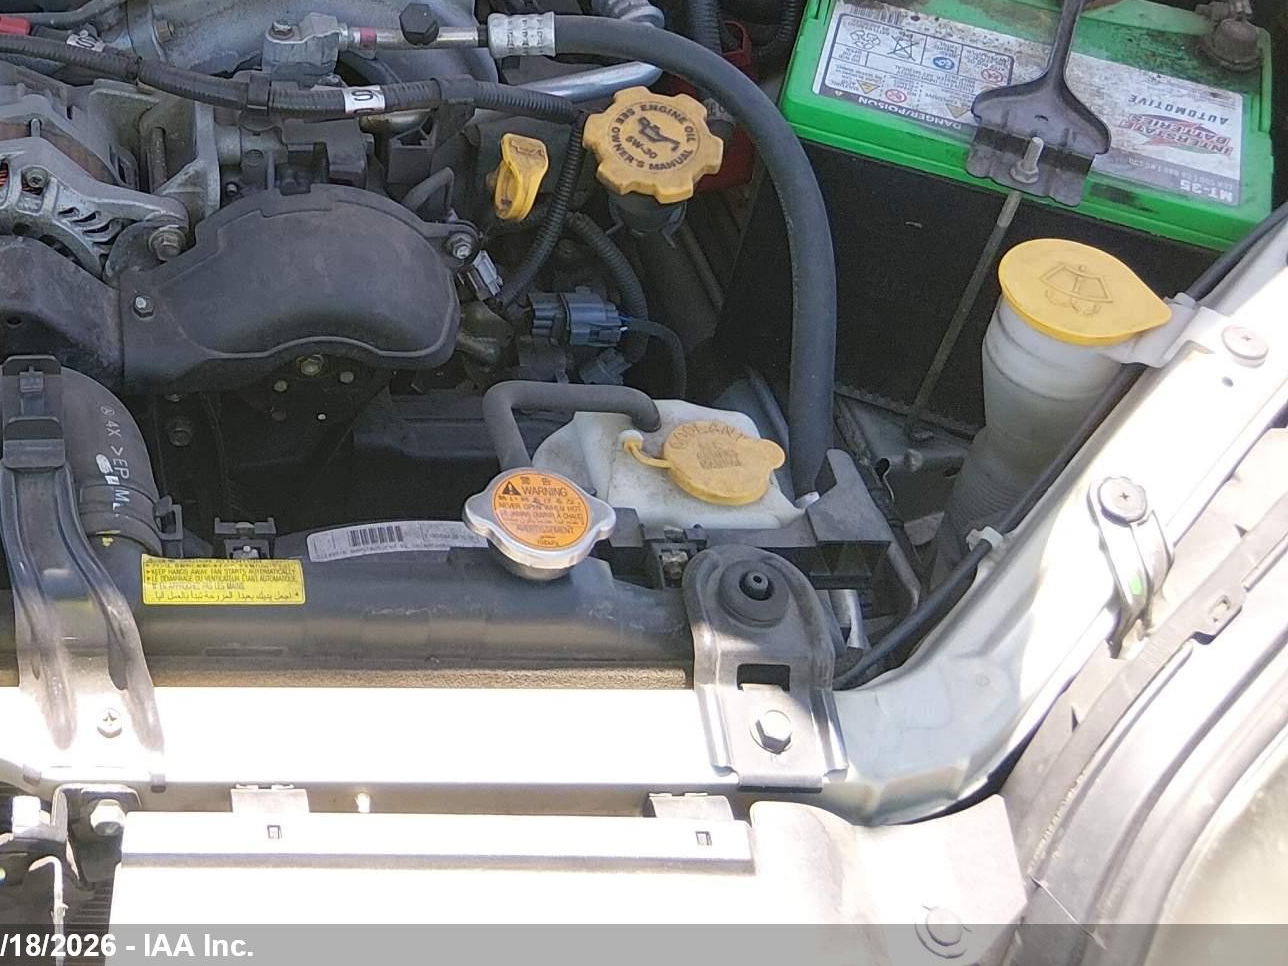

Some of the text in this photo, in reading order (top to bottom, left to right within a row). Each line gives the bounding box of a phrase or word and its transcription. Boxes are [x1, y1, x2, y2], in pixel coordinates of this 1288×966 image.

[640, 104, 697, 143] ENGINE OIL
[857, 96, 962, 130] DANGER/POISON
[1128, 95, 1229, 125] AUTOMOTIVE
[611, 108, 694, 171] SEE OWNER'S MANUAL
[1119, 120, 1234, 155] INTERSTATE
[1128, 114, 1230, 147] BATTERIES
[625, 135, 658, 160] 5W-30
[1179, 178, 1233, 203] MT-35
[521, 485, 568, 498] WARNING
